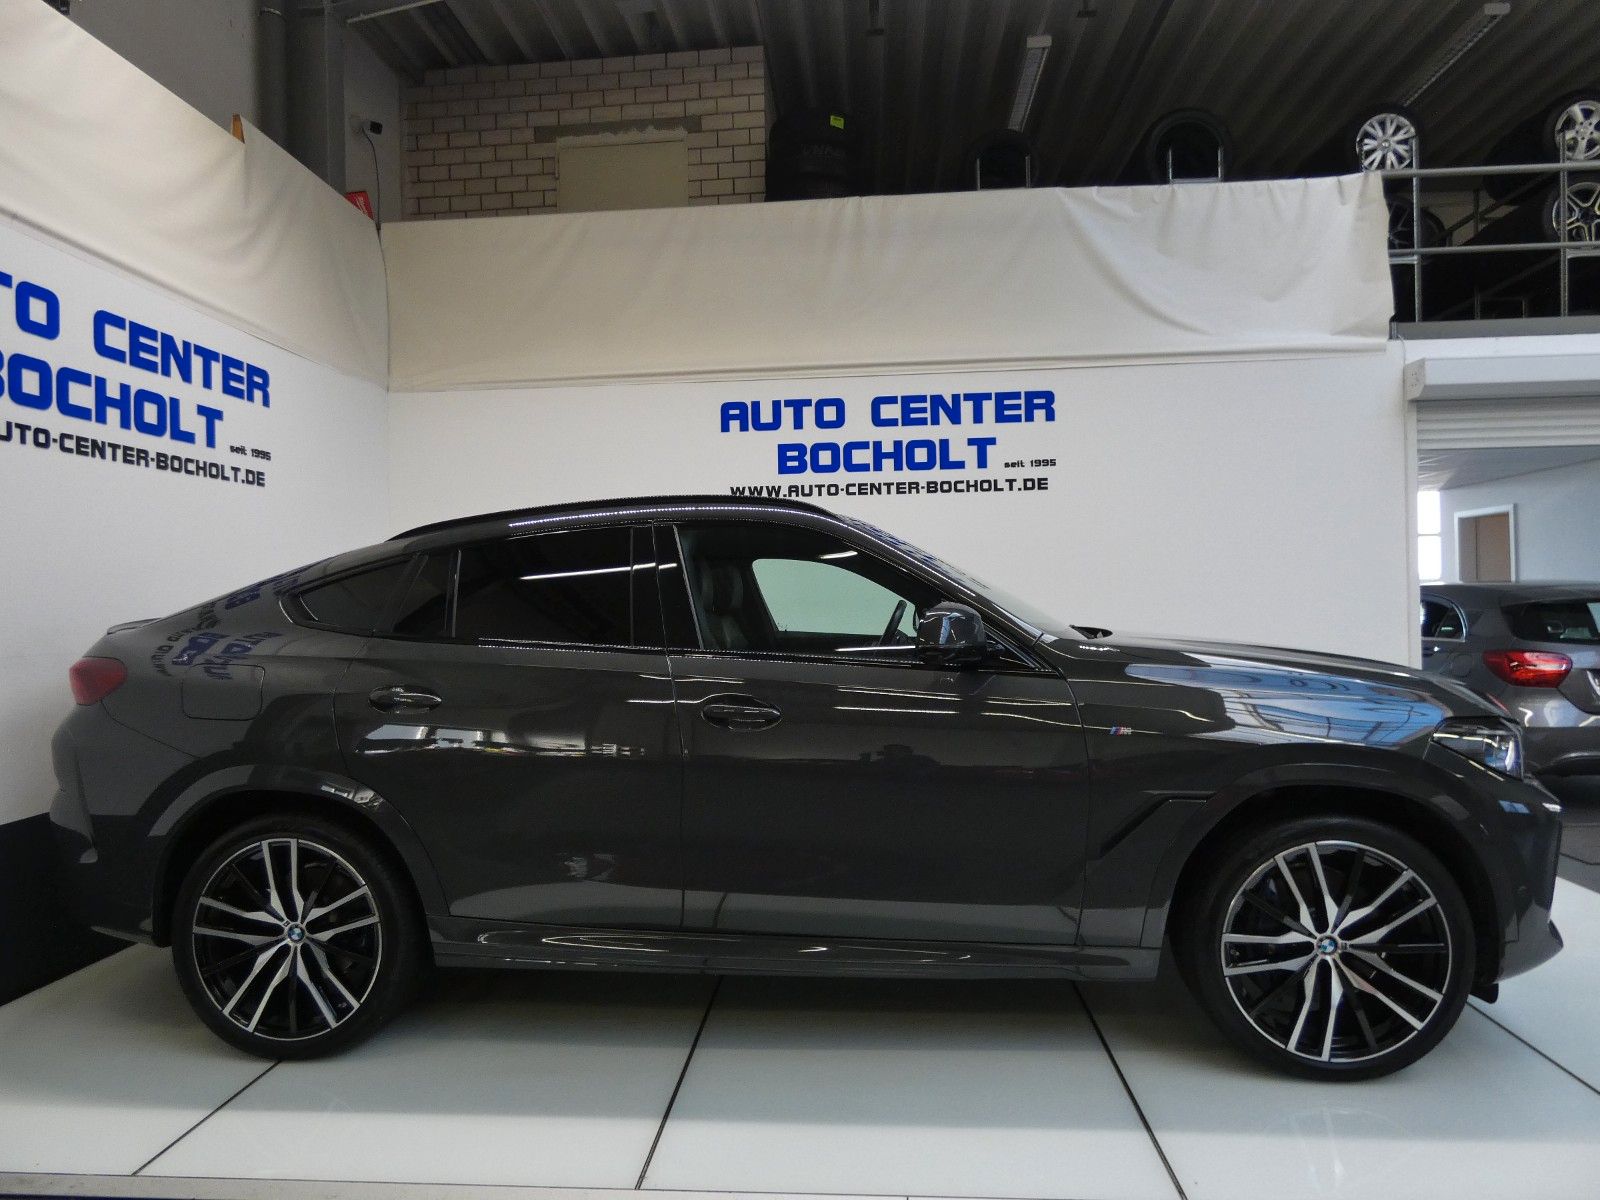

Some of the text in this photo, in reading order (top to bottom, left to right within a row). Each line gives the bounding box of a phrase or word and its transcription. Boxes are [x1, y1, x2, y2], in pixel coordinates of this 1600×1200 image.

[93, 309, 271, 408] CENTER
[0, 351, 272, 463] OCHOLT seit 1995
[720, 390, 1057, 432] AUTO CENTER
[777, 437, 1057, 475] BOCHOLT seit 1995
[730, 478, 1049, 500] WWW.AUTO-CENTER-BOCHOLT.DE
